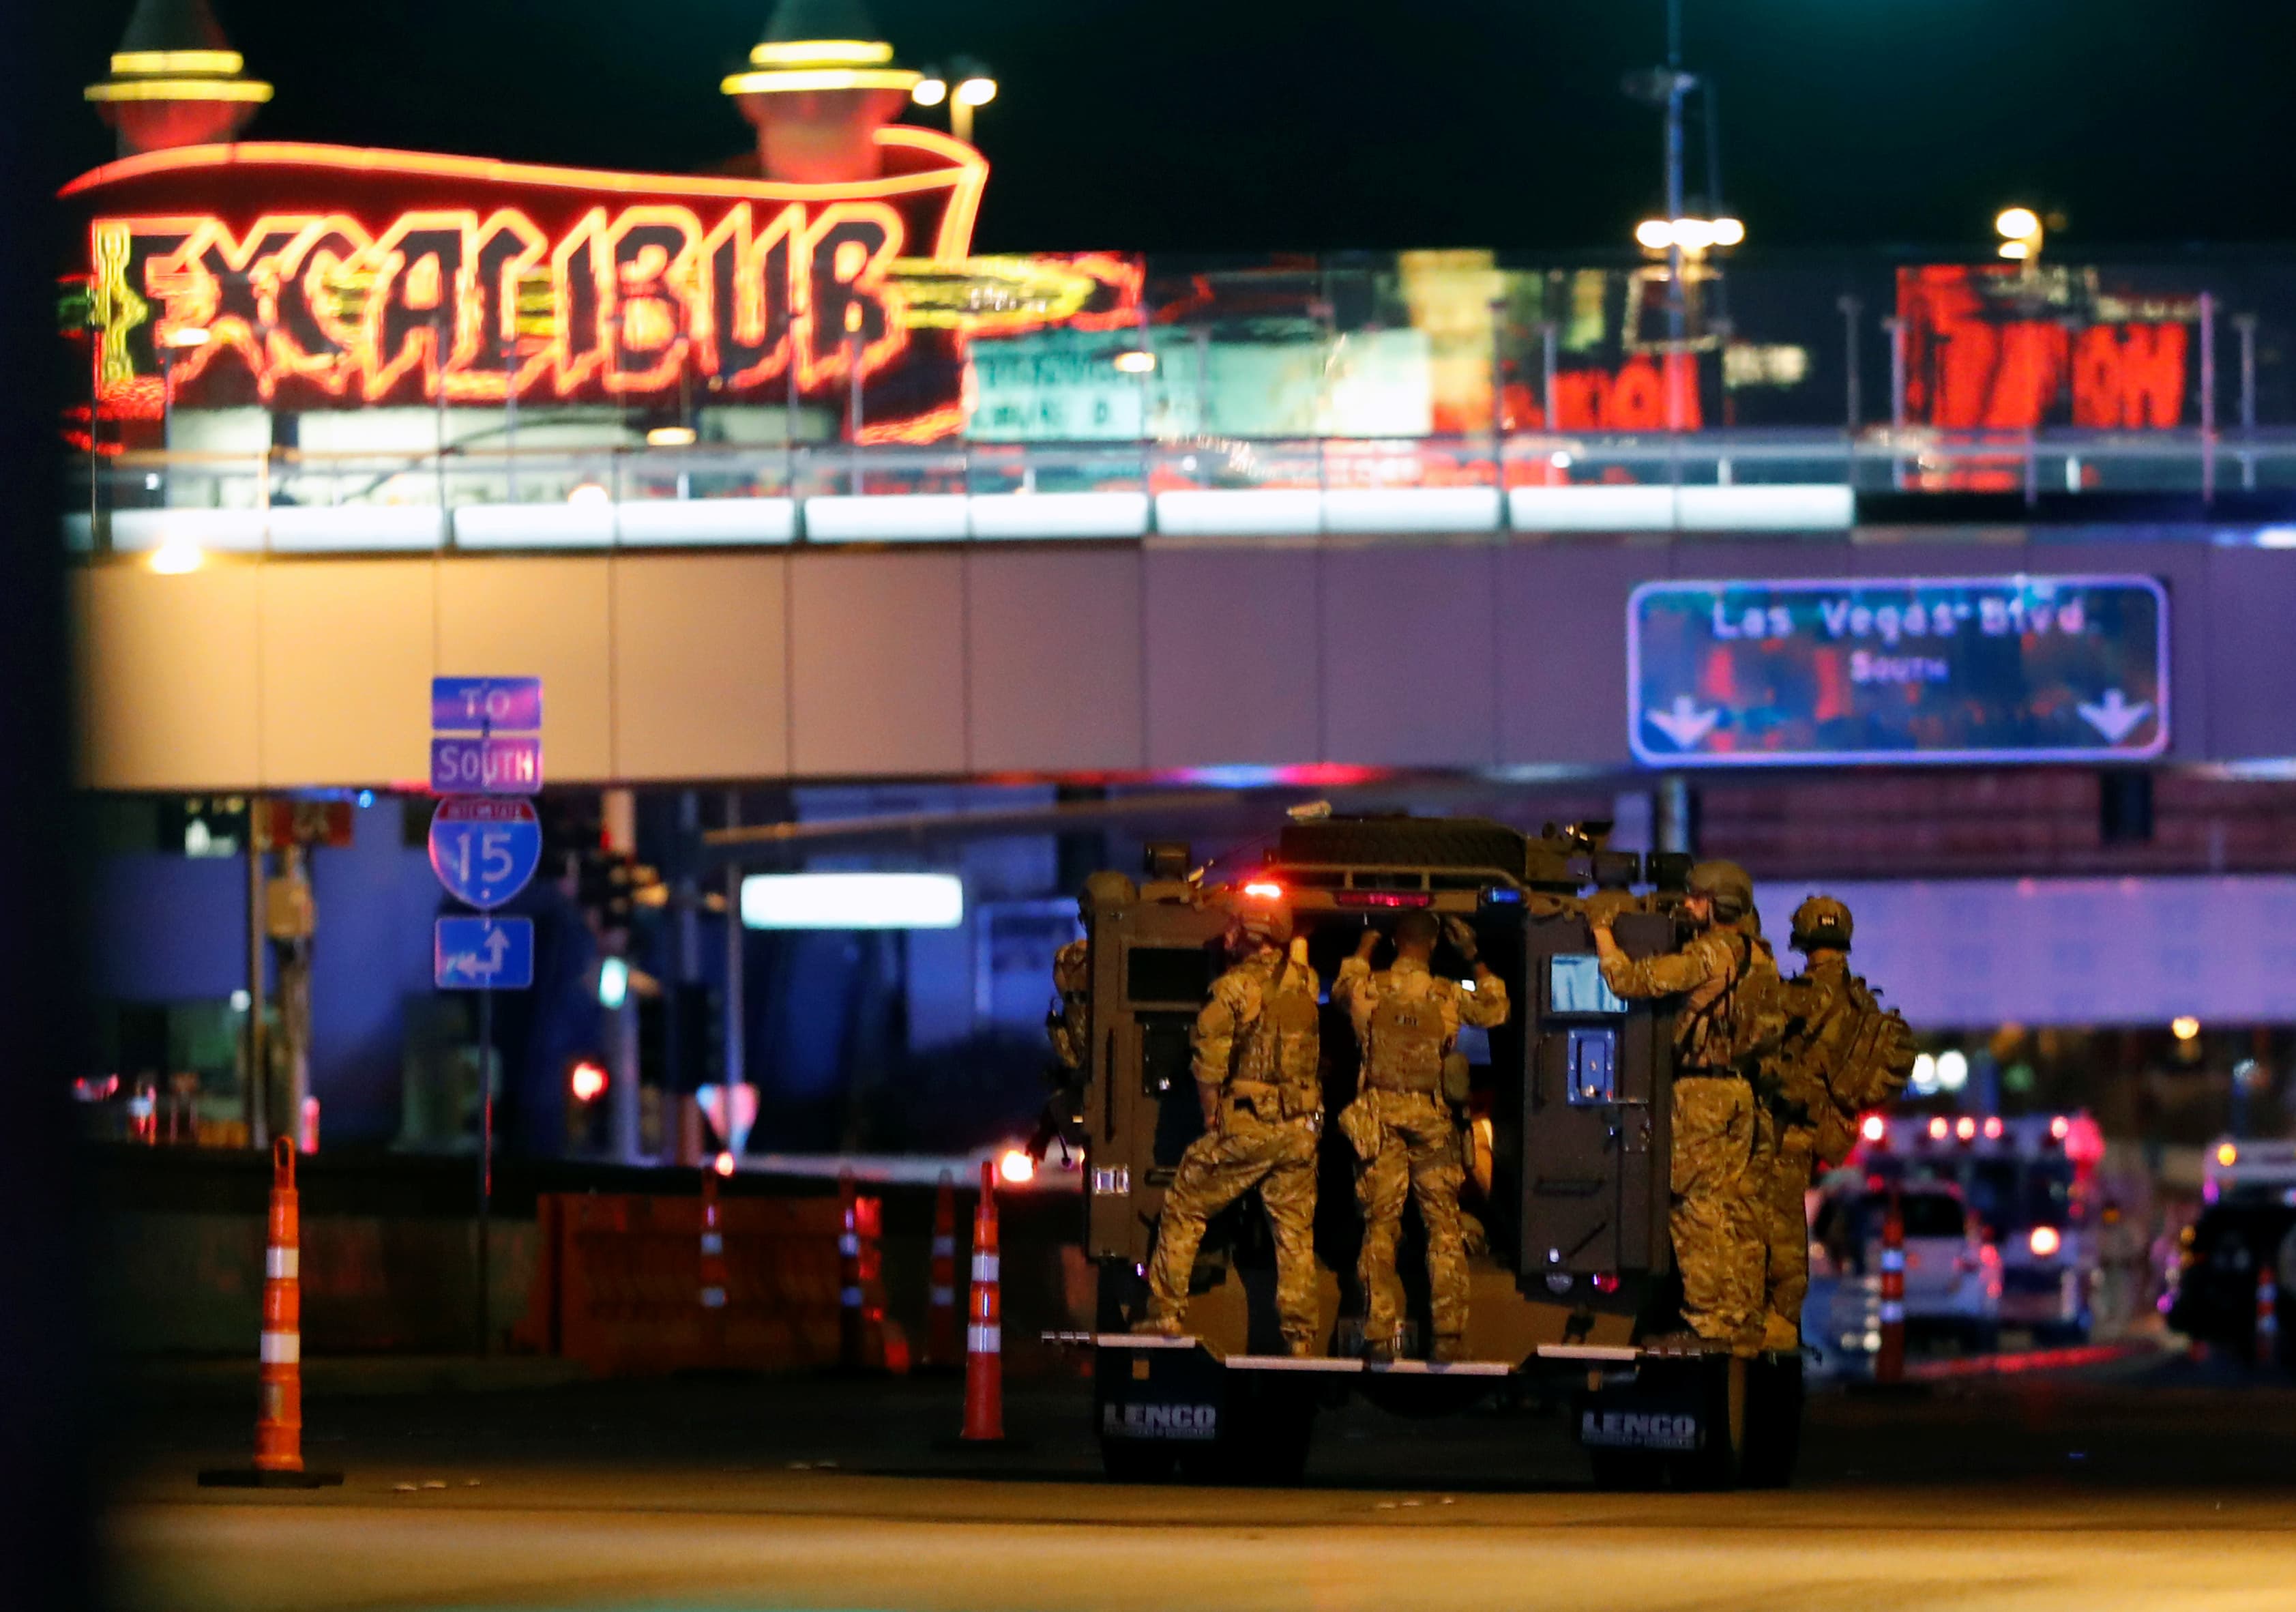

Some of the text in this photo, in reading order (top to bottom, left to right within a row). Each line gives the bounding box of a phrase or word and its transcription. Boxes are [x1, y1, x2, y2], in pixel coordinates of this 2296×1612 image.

[91, 202, 907, 401] EXCALIBUR
[1712, 600, 1794, 639] Las
[1821, 600, 1956, 645] Vegas
[460, 687, 511, 720] TO
[437, 745, 534, 784] SOUTH
[457, 832, 514, 884] 15
[1103, 1403, 1216, 1428] LENCO
[1583, 1410, 1696, 1436] LENCO
